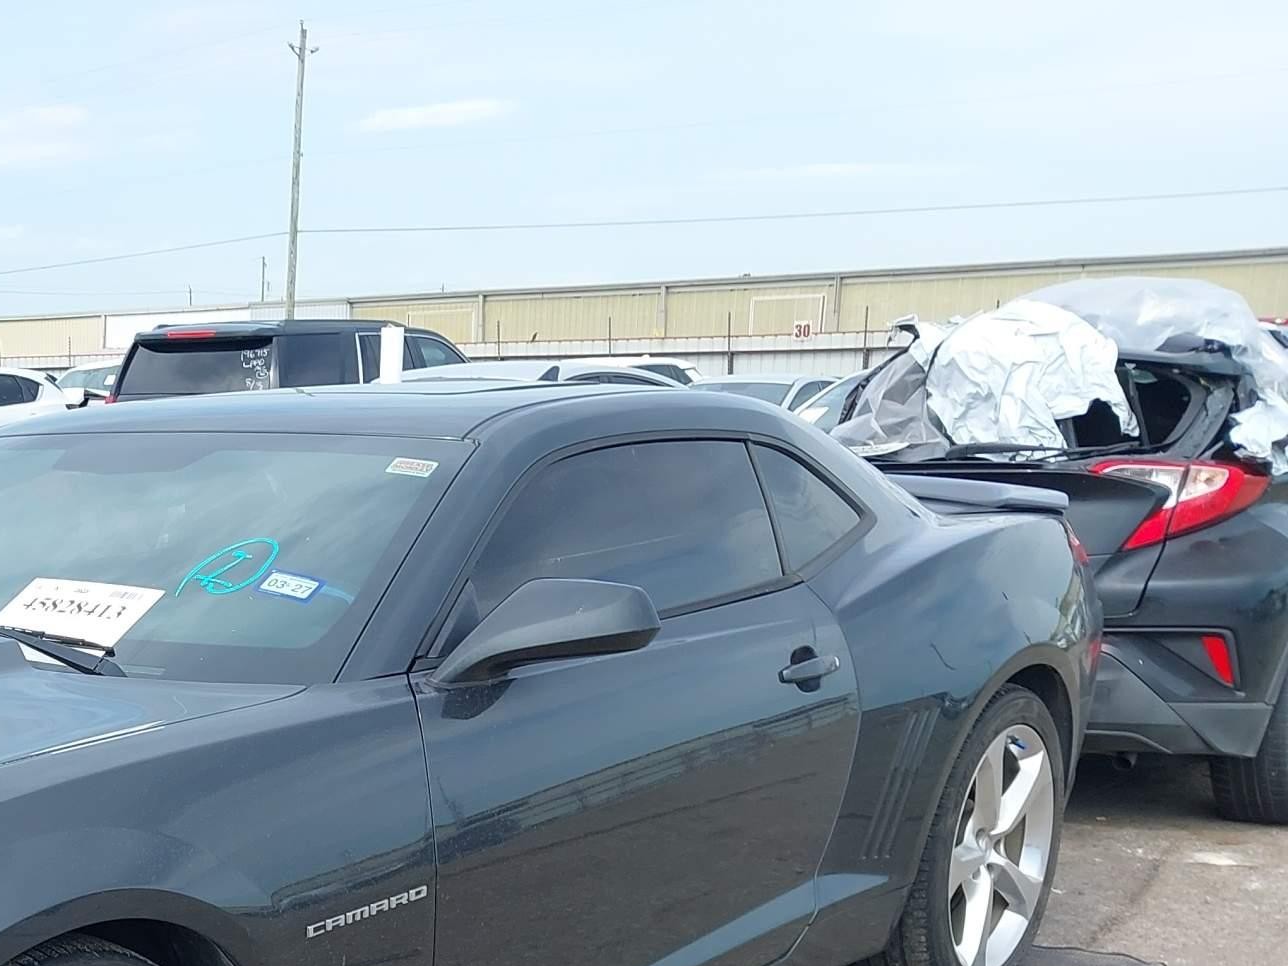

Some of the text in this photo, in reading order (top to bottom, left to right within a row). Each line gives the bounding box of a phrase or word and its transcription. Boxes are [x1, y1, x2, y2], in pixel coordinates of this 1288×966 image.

[795, 324, 811, 338] 30
[267, 578, 313, 595] 03 27
[306, 884, 428, 938] CAMARO
